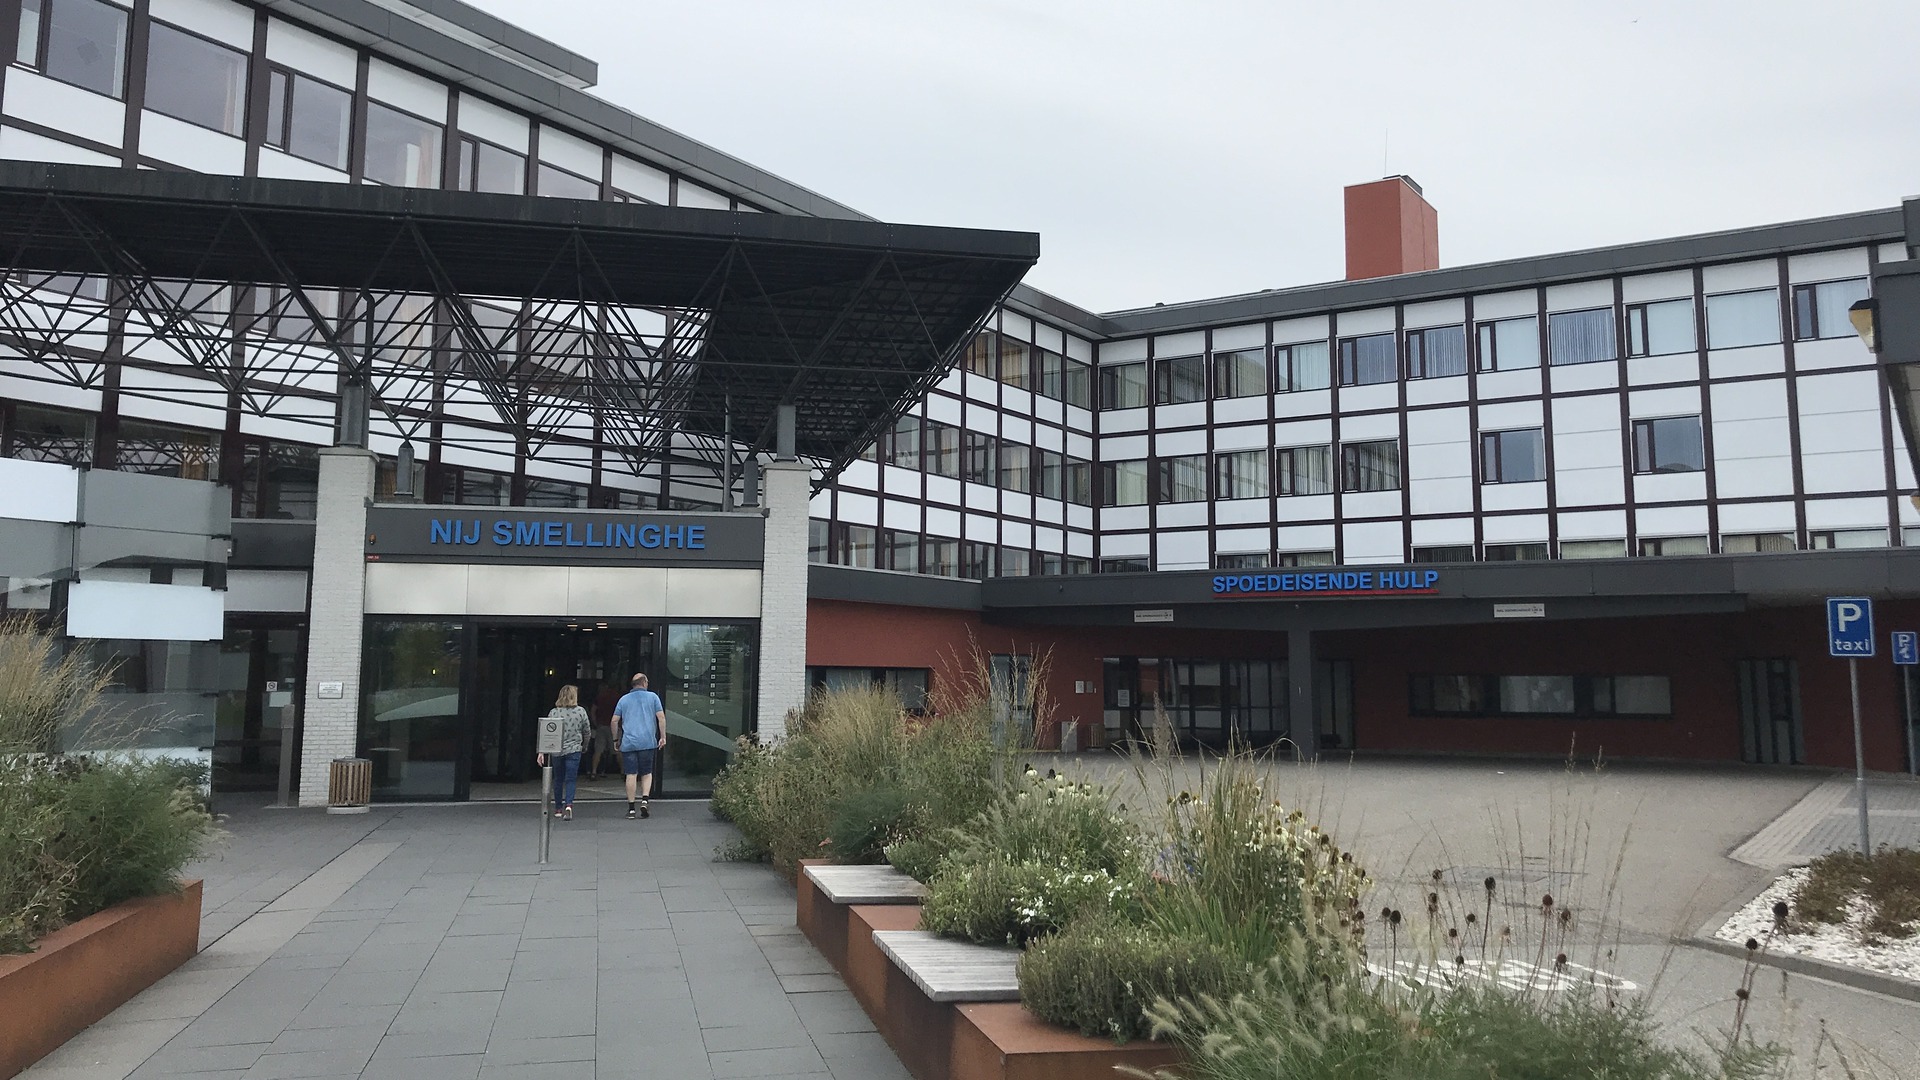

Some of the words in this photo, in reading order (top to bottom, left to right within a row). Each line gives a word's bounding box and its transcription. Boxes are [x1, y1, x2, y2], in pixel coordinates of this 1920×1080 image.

[430, 518, 482, 545] NIJ
[492, 519, 706, 550] SMELLINGHE
[1212, 571, 1373, 593] SPOEDEISENDE
[1378, 570, 1439, 590] HULP
[1837, 603, 1862, 632] P
[1835, 638, 1870, 651] taxi
[1898, 634, 1911, 647] P
